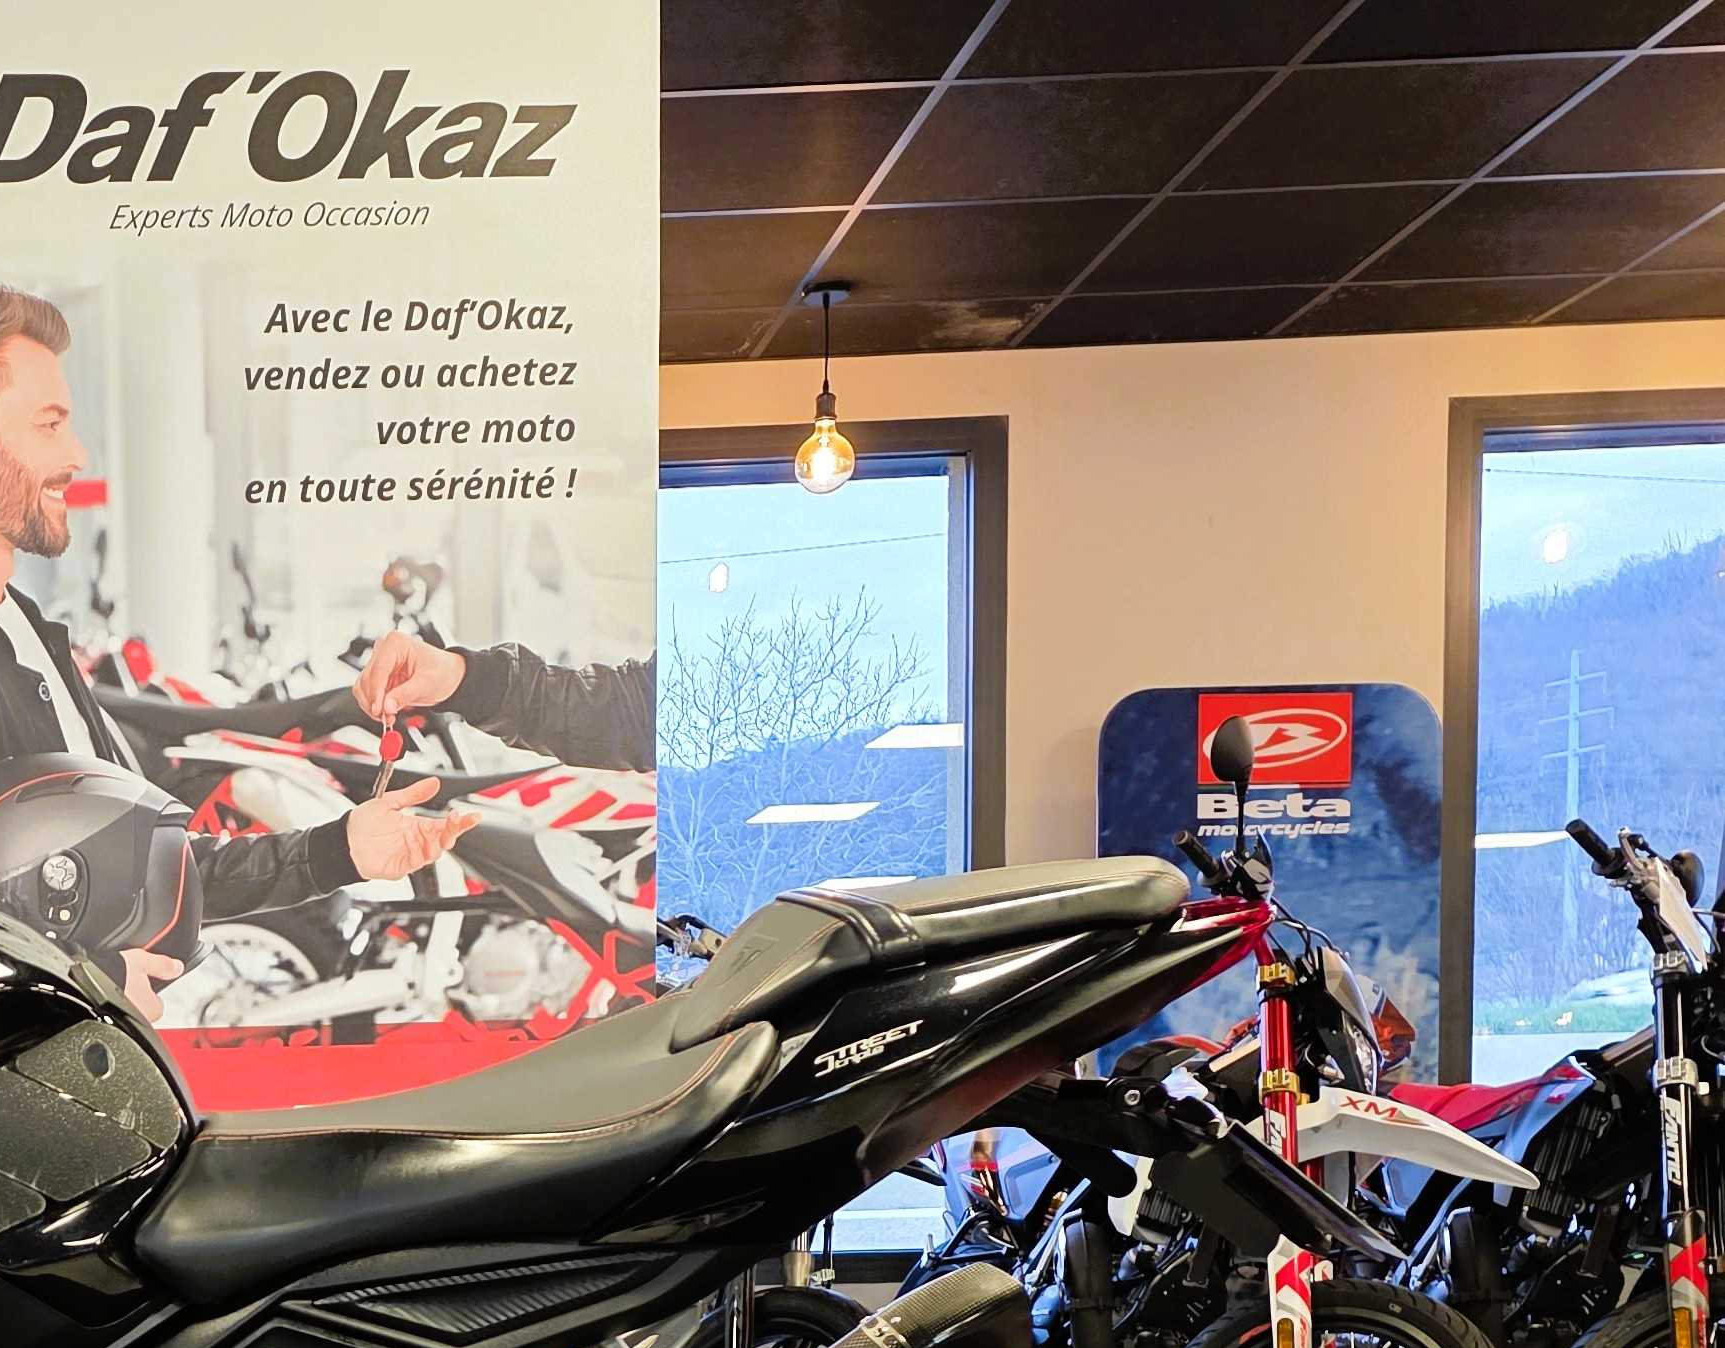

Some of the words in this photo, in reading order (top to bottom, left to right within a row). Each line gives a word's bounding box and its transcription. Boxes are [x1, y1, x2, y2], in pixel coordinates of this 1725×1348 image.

[109, 202, 212, 237] Experts
[220, 201, 294, 230] Moto
[302, 199, 430, 229] Occasion
[265, 303, 350, 334] Avec
[361, 300, 393, 332] le
[403, 298, 576, 341] Daf'Okaz,
[243, 359, 369, 393] vendez
[381, 364, 425, 390] ou
[436, 355, 578, 389] achetez
[376, 417, 470, 445] votre
[481, 414, 576, 443] moto
[244, 479, 287, 505] en
[298, 474, 395, 504] toute
[407, 467, 556, 503] sérénité
[1196, 792, 1352, 820] Beta
